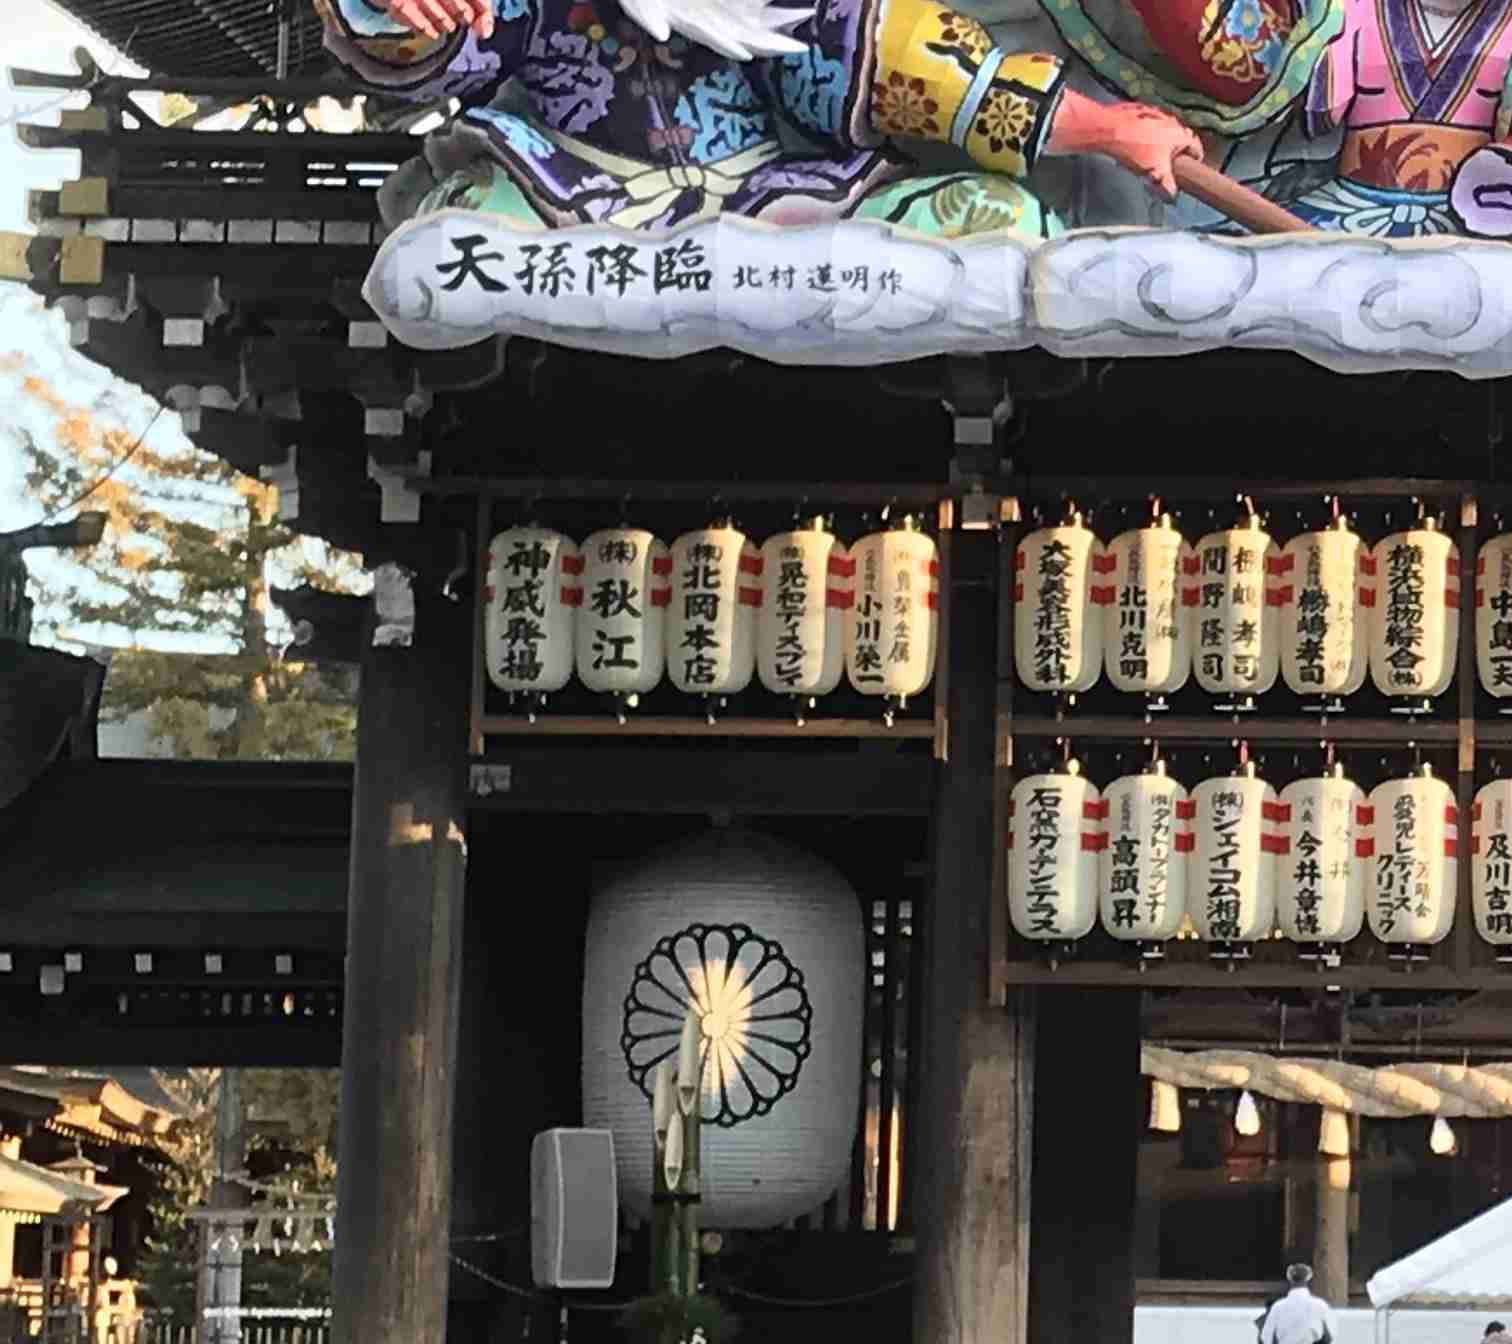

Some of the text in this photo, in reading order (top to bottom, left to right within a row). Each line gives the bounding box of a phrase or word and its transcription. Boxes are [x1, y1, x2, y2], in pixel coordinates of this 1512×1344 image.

[435, 234, 711, 297] 天孫降臨
[1120, 585, 1149, 681] 北川克明
